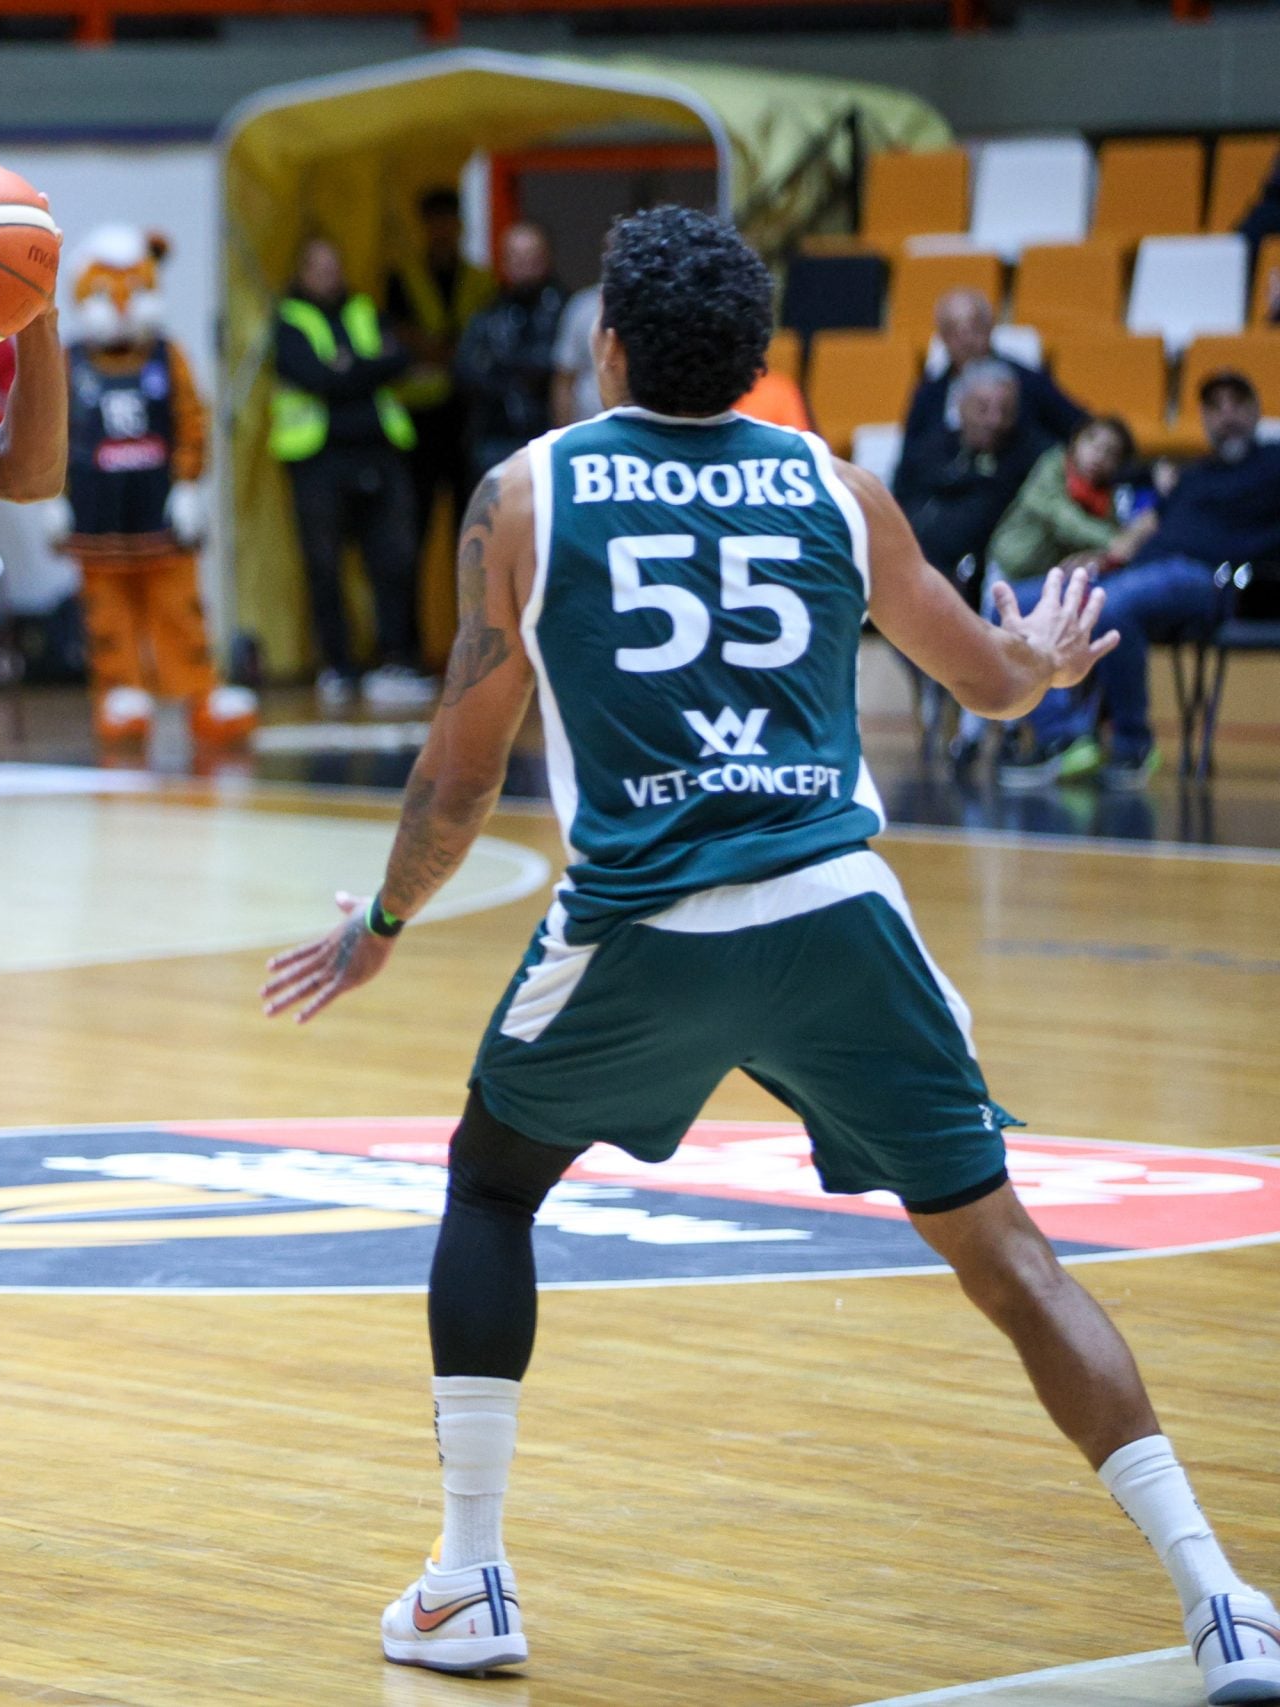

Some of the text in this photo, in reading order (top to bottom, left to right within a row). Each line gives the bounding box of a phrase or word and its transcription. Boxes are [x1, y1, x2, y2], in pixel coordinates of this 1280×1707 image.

[570, 454, 817, 507] BROOKS
[607, 534, 812, 673] 55
[622, 763, 841, 808] VET-CONCEPT
